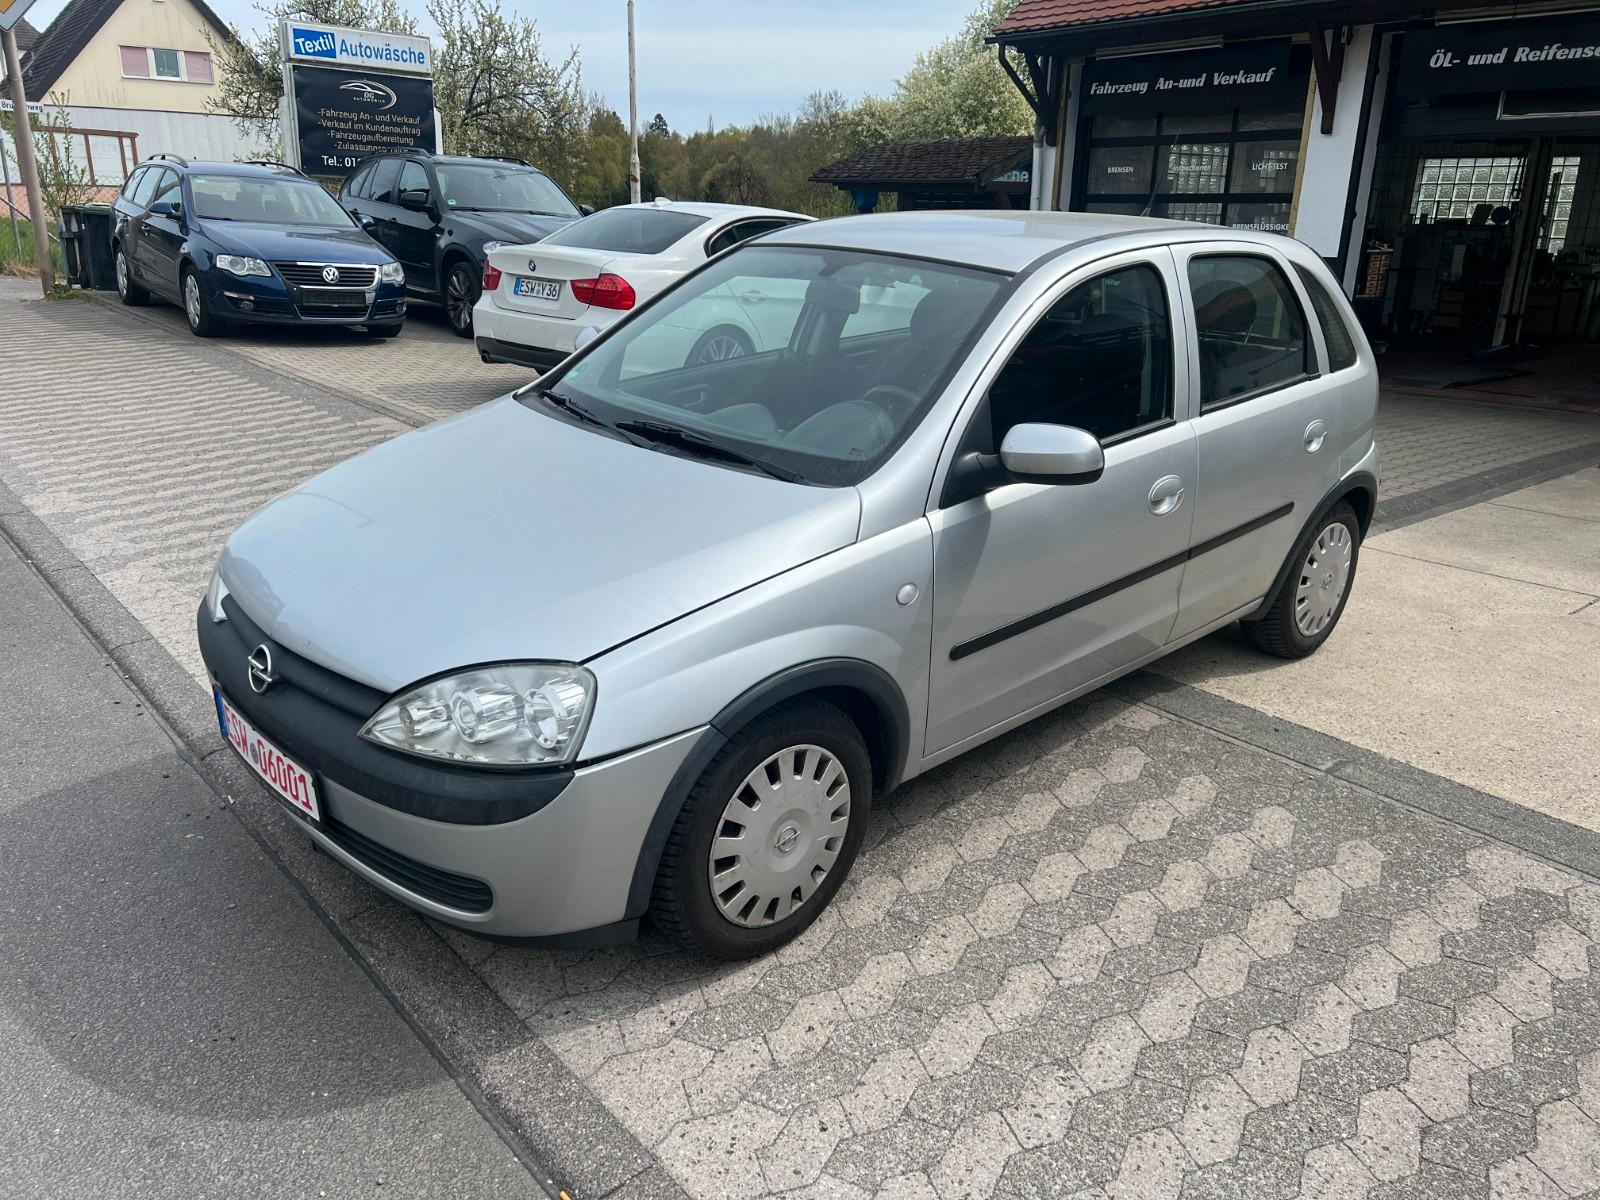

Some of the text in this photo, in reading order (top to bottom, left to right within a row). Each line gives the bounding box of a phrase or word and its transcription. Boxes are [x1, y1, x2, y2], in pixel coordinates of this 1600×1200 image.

[294, 33, 425, 65] Textil Autowäsche
[1429, 48, 1460, 68] ÖL-
[1467, 48, 1509, 66] und
[1090, 67, 1277, 95] Fahrzeug An-und Verkauf
[359, 111, 374, 120] An-
[391, 114, 420, 124] Verkauf
[353, 122, 364, 130] im
[365, 123, 421, 137] Kundenauftrag
[321, 155, 361, 167] Tel.: 01
[1107, 165, 1134, 174] BREMSEN
[256, 738, 313, 812] 06001
